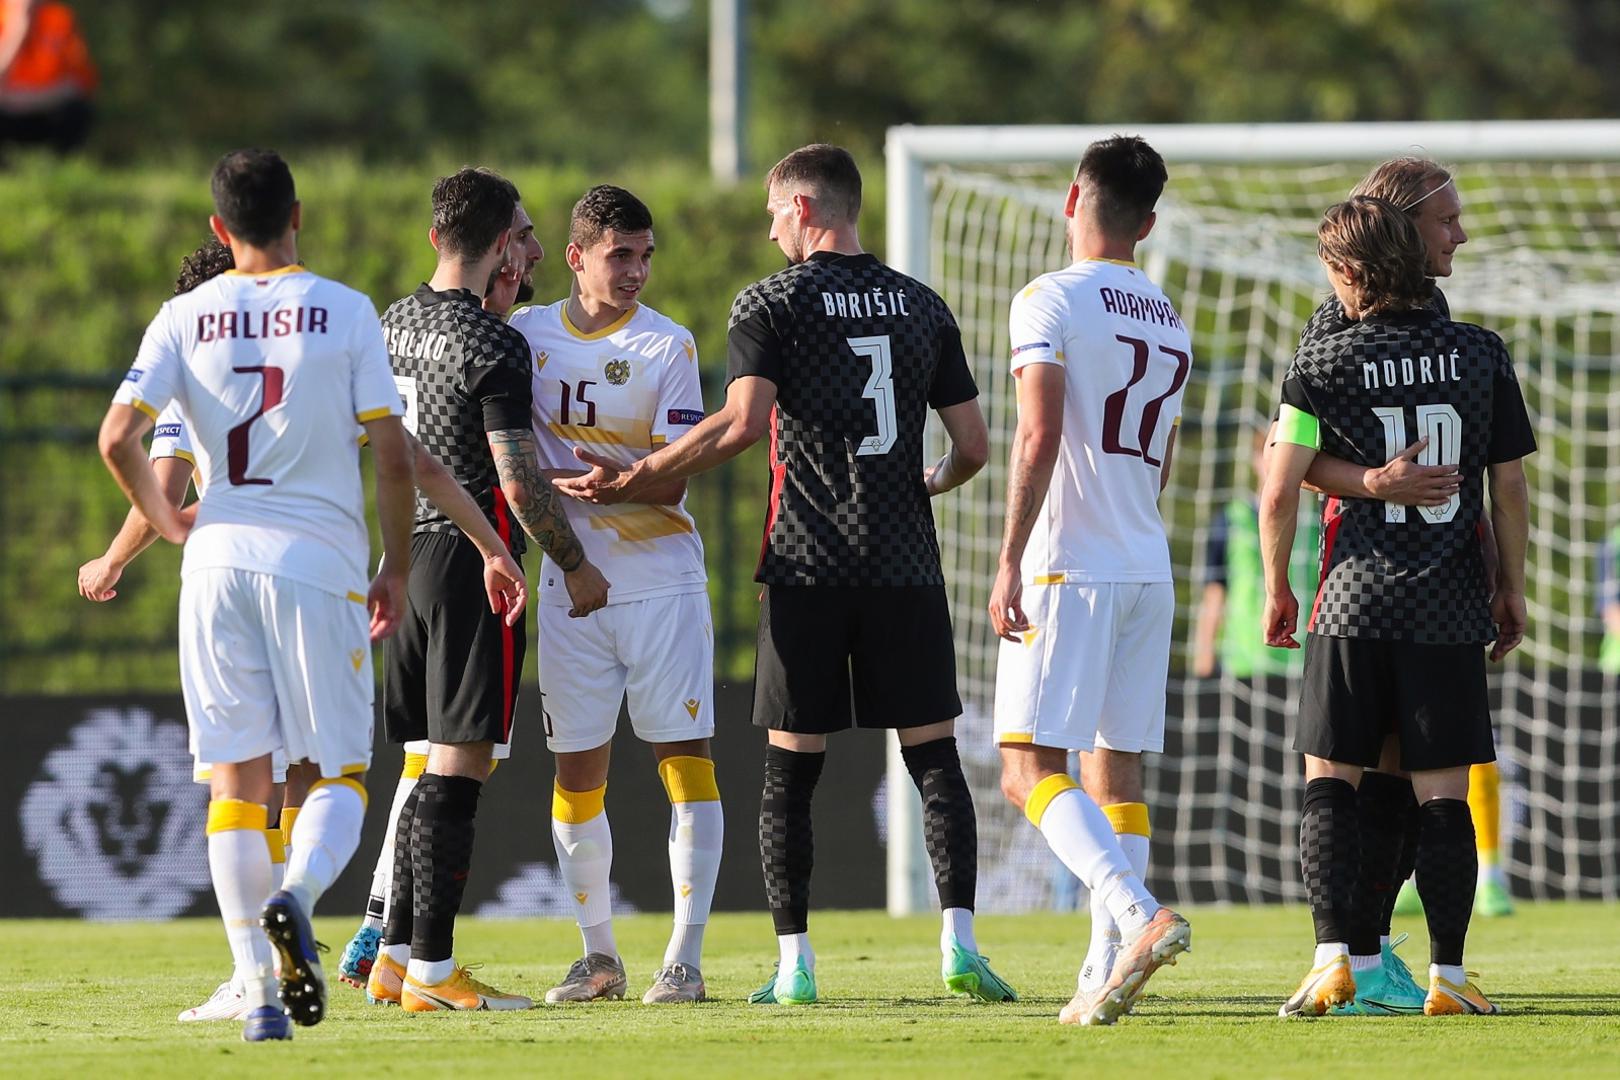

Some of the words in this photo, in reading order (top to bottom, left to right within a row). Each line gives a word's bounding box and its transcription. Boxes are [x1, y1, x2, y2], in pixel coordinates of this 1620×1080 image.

[198, 307, 327, 342] CALISIR
[822, 288, 909, 318] BARIŠIĆ
[560, 380, 597, 427] 15
[846, 335, 898, 456] 3
[1102, 334, 1189, 467] 22
[1364, 349, 1461, 389] MODRIĆ
[228, 366, 284, 485] 2
[1371, 404, 1462, 524] 10
